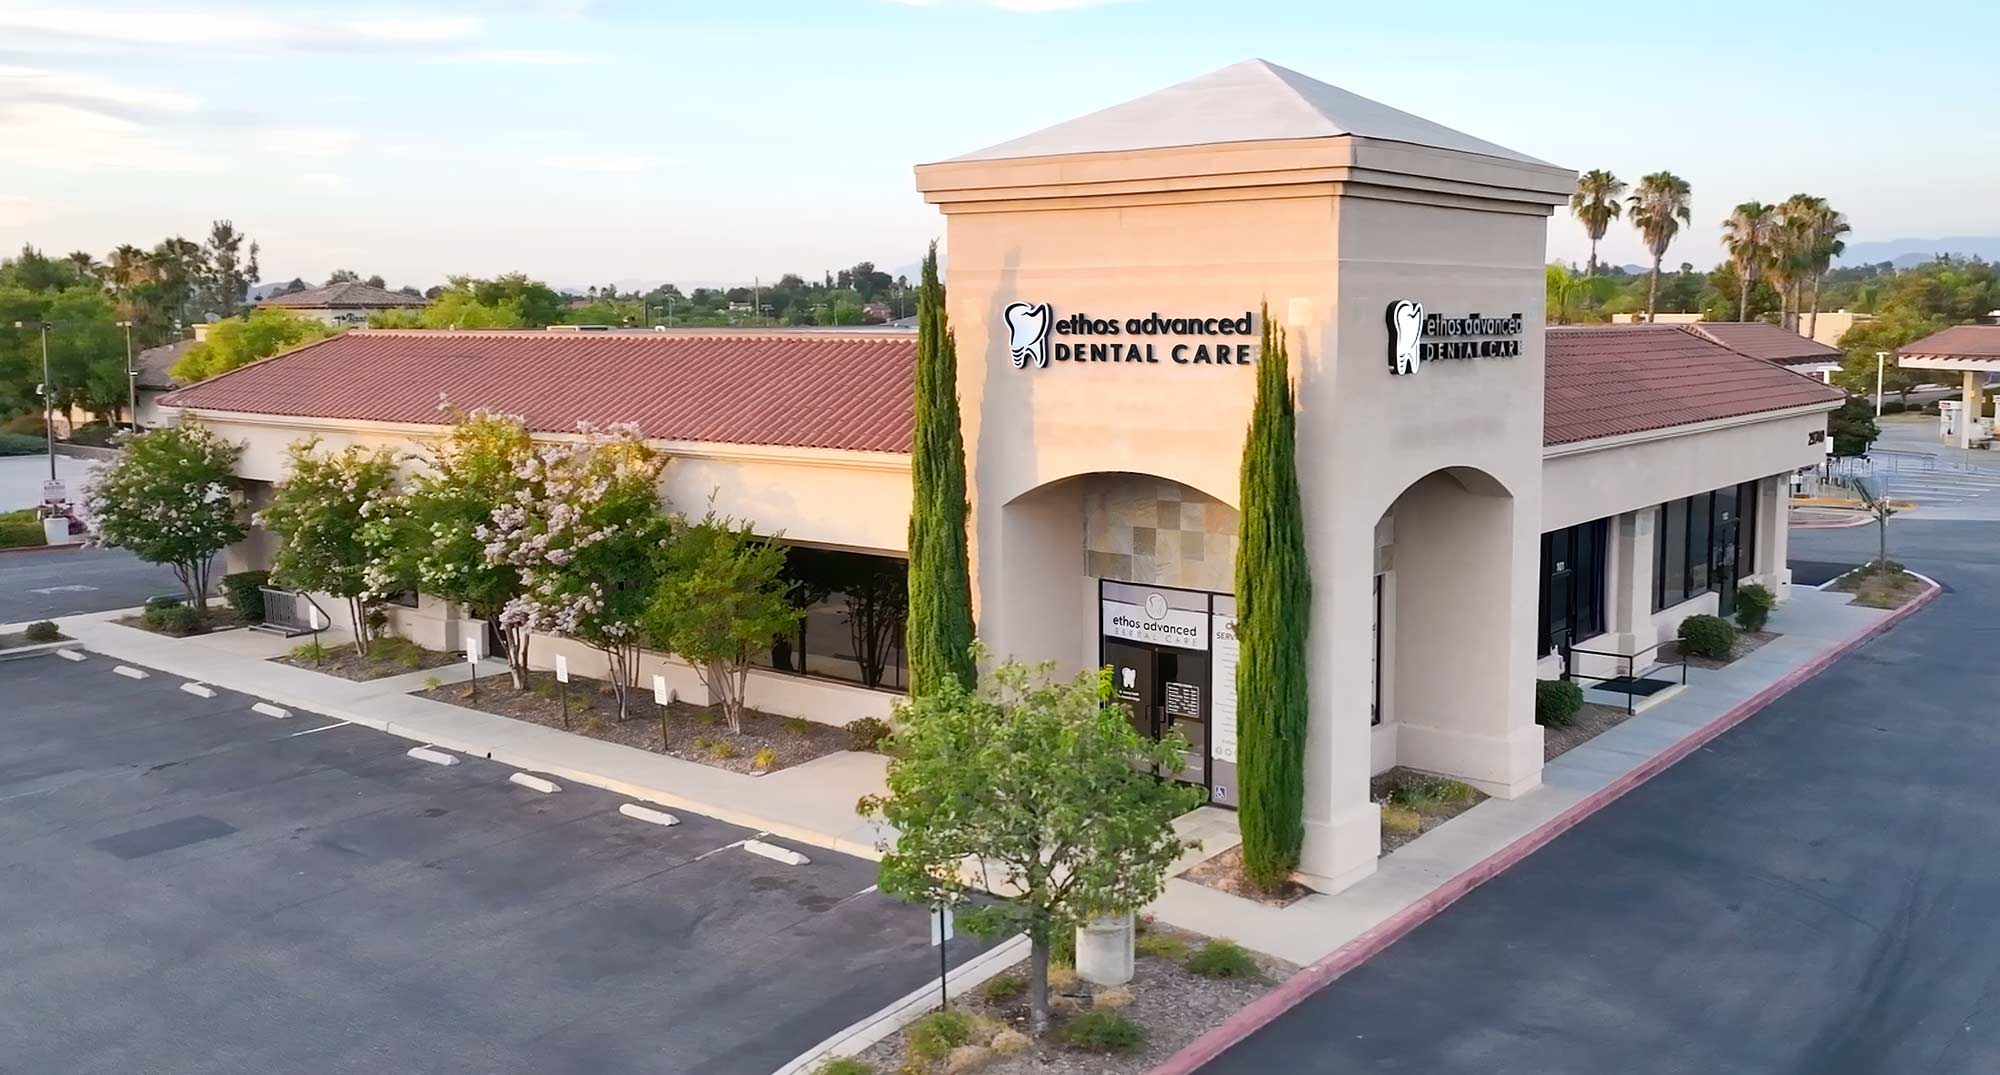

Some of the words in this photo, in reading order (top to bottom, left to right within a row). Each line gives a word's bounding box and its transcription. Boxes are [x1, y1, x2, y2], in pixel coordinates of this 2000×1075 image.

[1055, 313, 1120, 335] ethos
[1125, 312, 1252, 335] advanced
[1425, 313, 1462, 336] ethos
[1464, 313, 1523, 334] advanced
[1055, 343, 1159, 363] DENTAL
[1171, 344, 1251, 364] CARE
[1425, 342, 1482, 361] DENTAL
[1112, 615, 1141, 629] ethos
[1143, 621, 1198, 637] advanced
